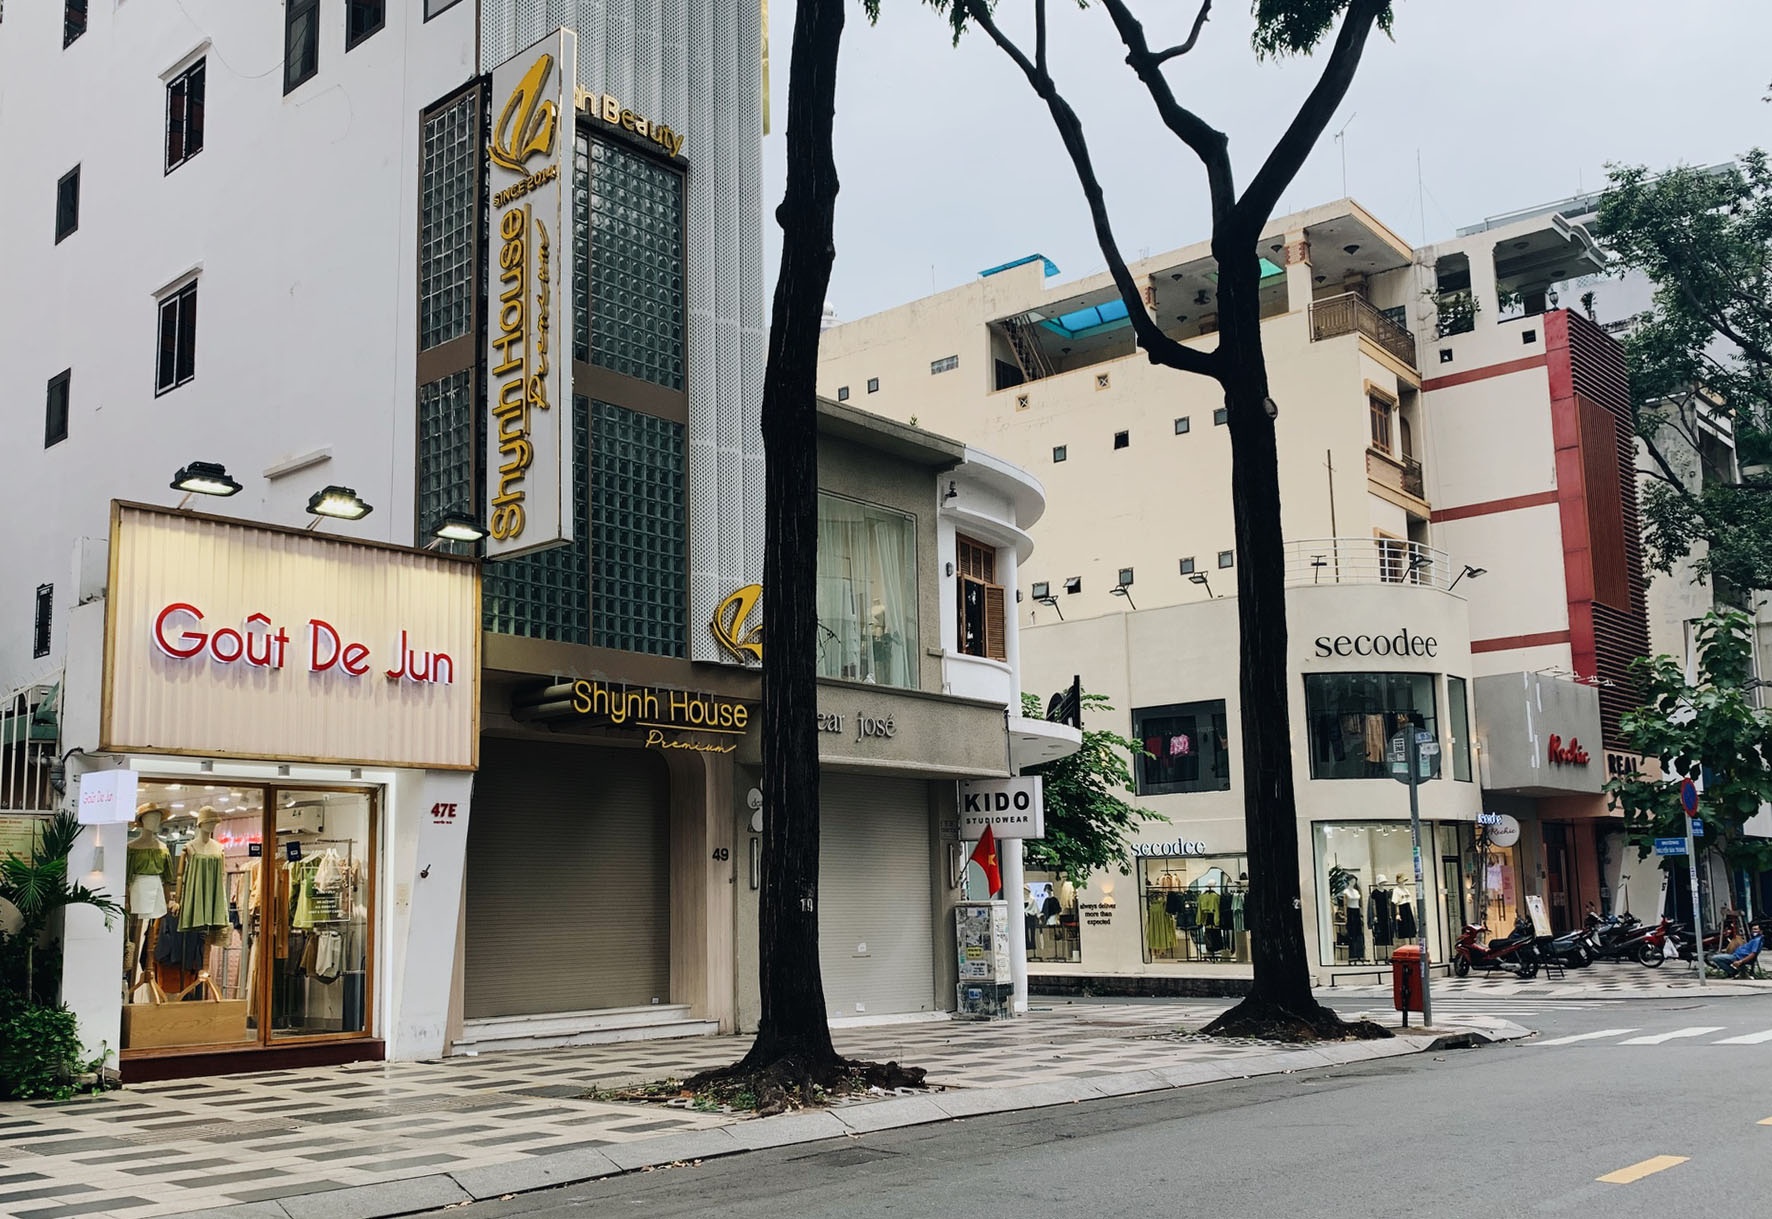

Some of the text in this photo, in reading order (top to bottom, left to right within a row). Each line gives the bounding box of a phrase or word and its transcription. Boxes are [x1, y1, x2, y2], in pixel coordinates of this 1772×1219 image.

[601, 93, 684, 157] Beauty
[493, 165, 557, 209] SINCE 2014
[491, 207, 533, 540] Shynh House
[152, 602, 453, 684] Goût De Jun
[1314, 628, 1437, 657] secodee
[573, 680, 748, 727] Shynh House
[856, 711, 897, 741] josé
[645, 729, 737, 753] Premium
[431, 803, 457, 818] 47E
[964, 791, 1030, 812] KIDO
[966, 816, 1029, 825] STUDIOWEAR
[712, 848, 729, 861] 49
[1130, 837, 1206, 856] secodee
[1087, 918, 1111, 926] expected
